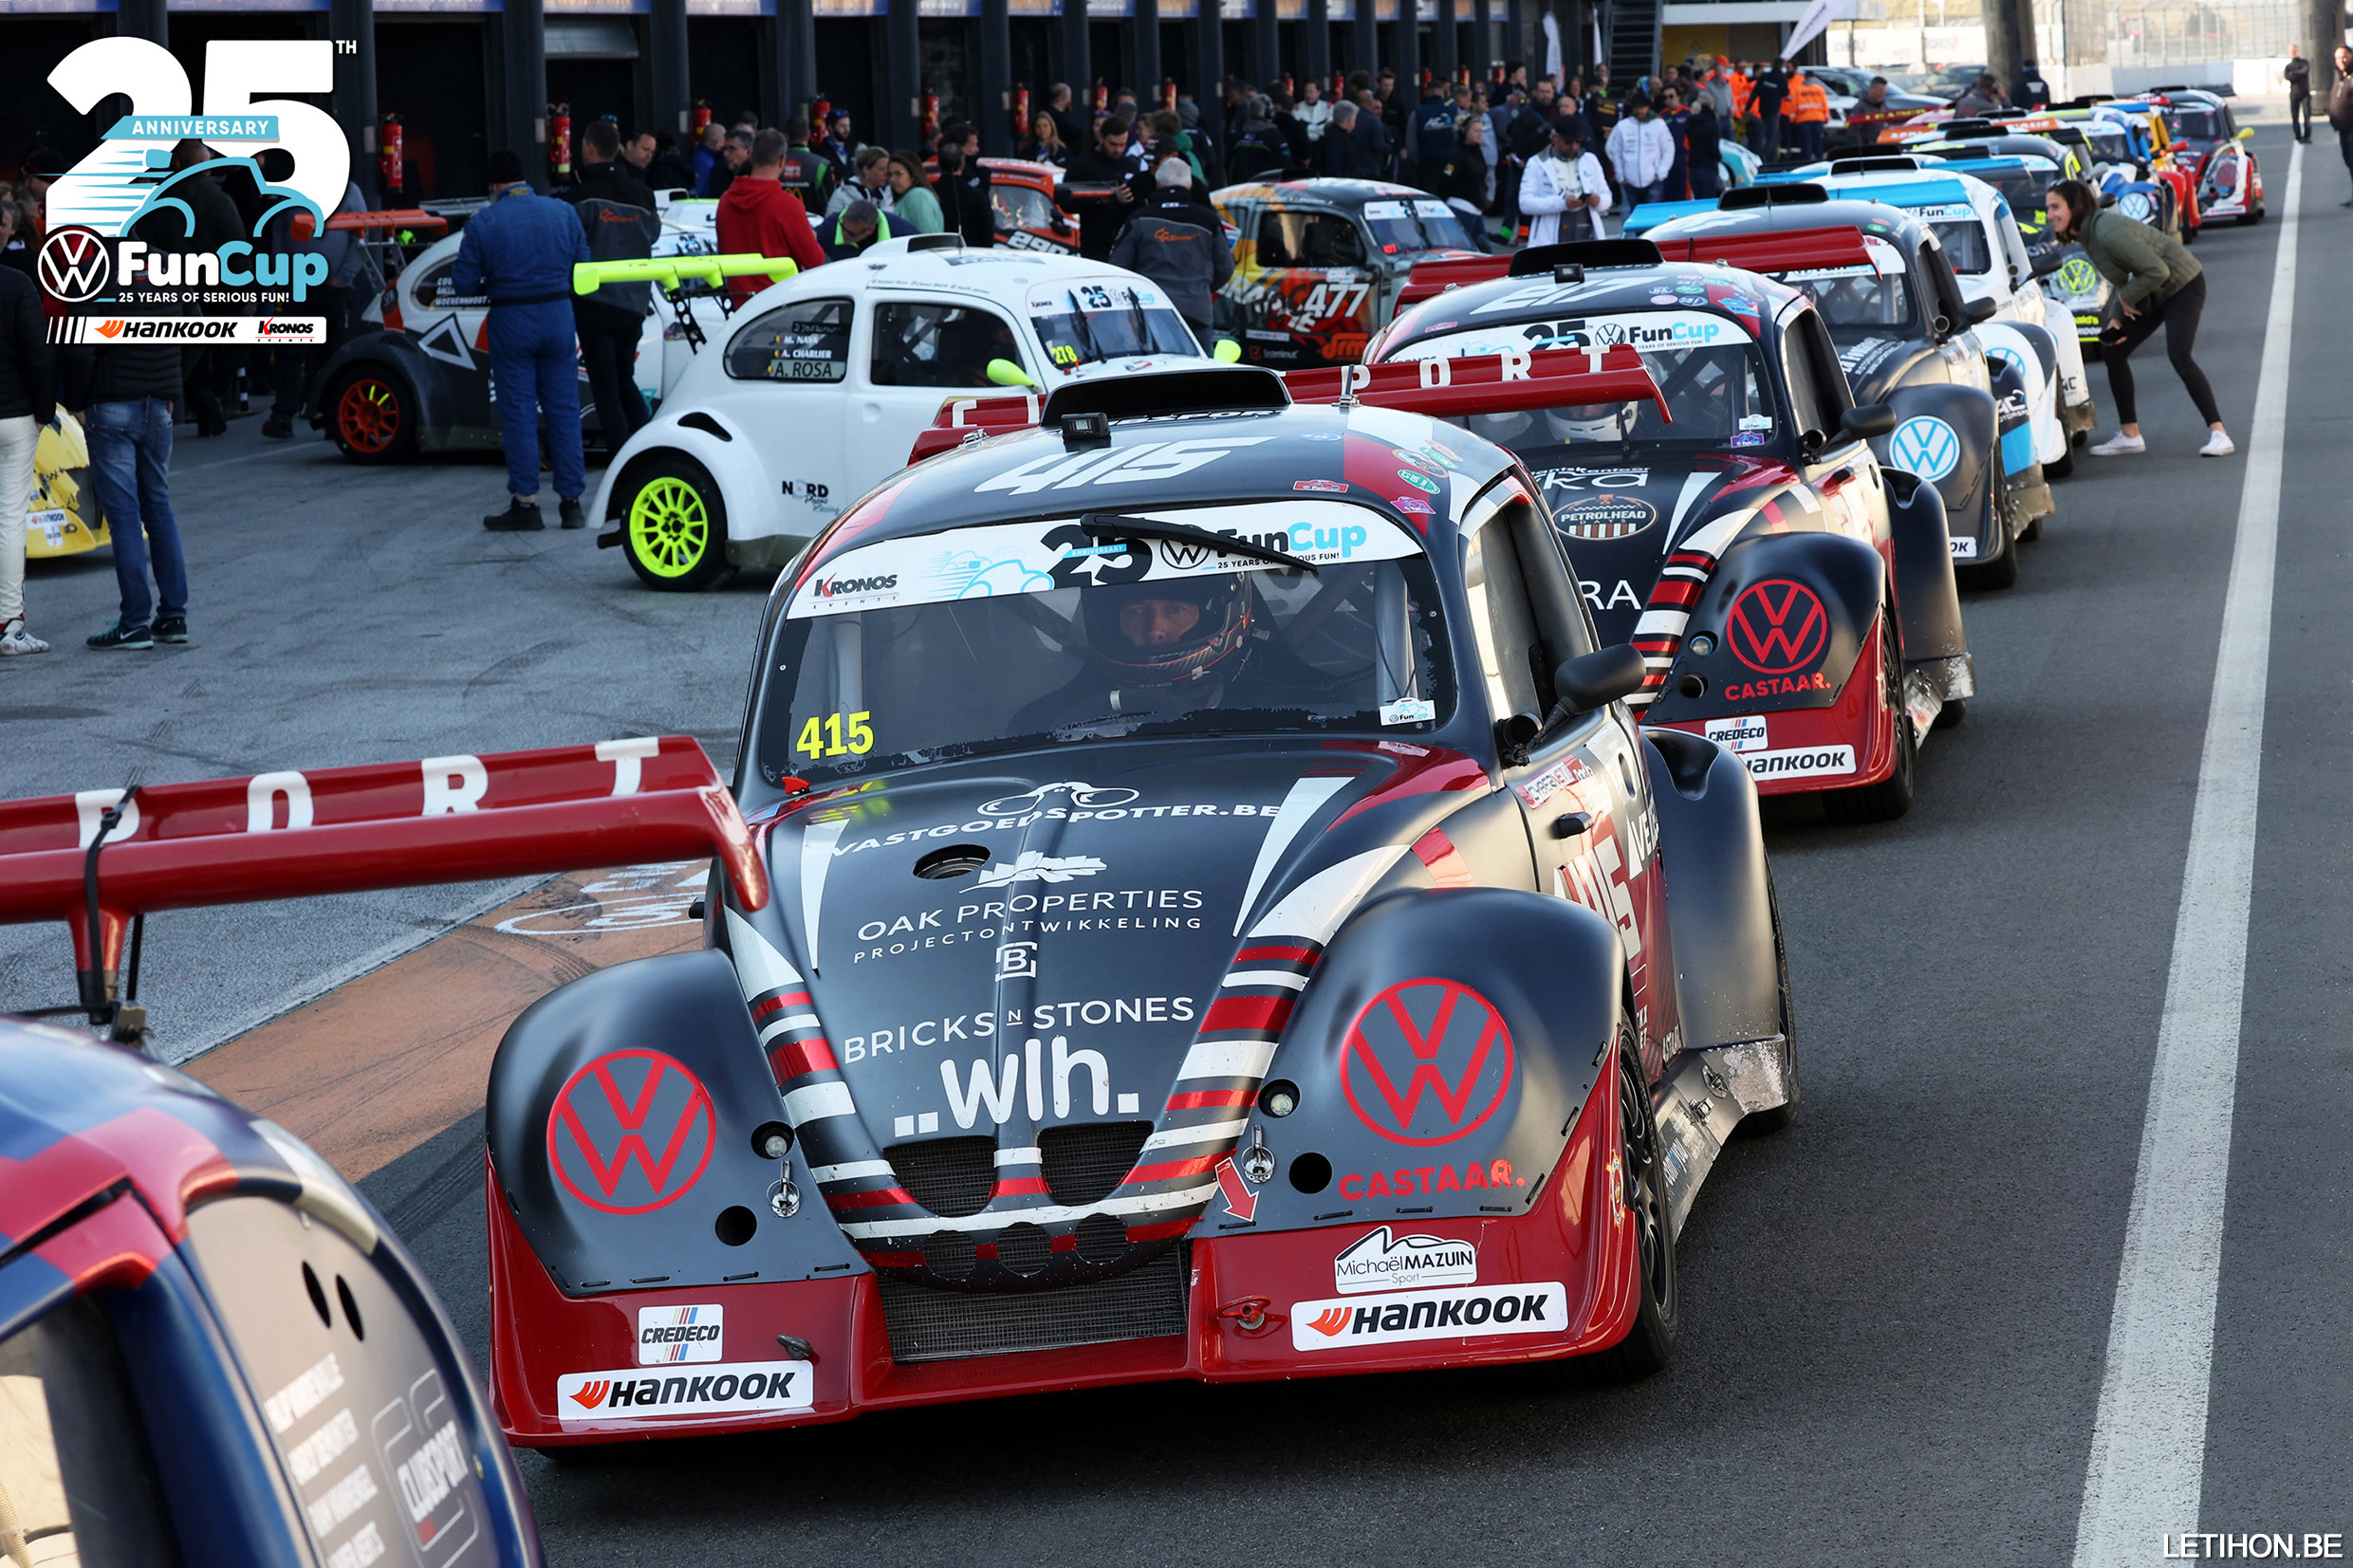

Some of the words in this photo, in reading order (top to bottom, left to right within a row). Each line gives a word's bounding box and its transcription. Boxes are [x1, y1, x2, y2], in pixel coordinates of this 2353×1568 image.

[1918, 206, 1972, 218] FunCup
[1304, 284, 1370, 319] 477
[1628, 322, 1720, 342] FunCup
[793, 349, 833, 359] CHARLIER
[1050, 345, 1078, 364] 278
[774, 362, 791, 378] A.
[792, 361, 833, 378] ROSA
[974, 435, 1279, 495] 415
[1560, 509, 1647, 523] PETROLHEAD
[1216, 522, 1367, 558] FunCup
[1070, 544, 1124, 558] ANNIVERSARY
[1231, 559, 1260, 569] YEARS
[1319, 552, 1340, 562] FUN!
[813, 572, 899, 598] KRONOS
[1724, 672, 1832, 701] CASTAAR.
[1399, 712, 1429, 721] FunCup
[795, 710, 876, 761] 415
[1708, 727, 1765, 743] CREDECO
[832, 803, 1283, 858] VASTGOEDSPOTTER.BE
[857, 907, 944, 943] OAK
[956, 890, 1204, 925] PROPERTIES
[853, 916, 1202, 964] PROJECTONTWIKKELING
[843, 1012, 995, 1065] BRICKS
[1007, 1008, 1022, 1024] N
[1032, 996, 1195, 1030] STONES
[1338, 1158, 1526, 1202] CASTAAR.
[1391, 1271, 1420, 1286] Sport
[640, 1323, 721, 1344] CREDECO
